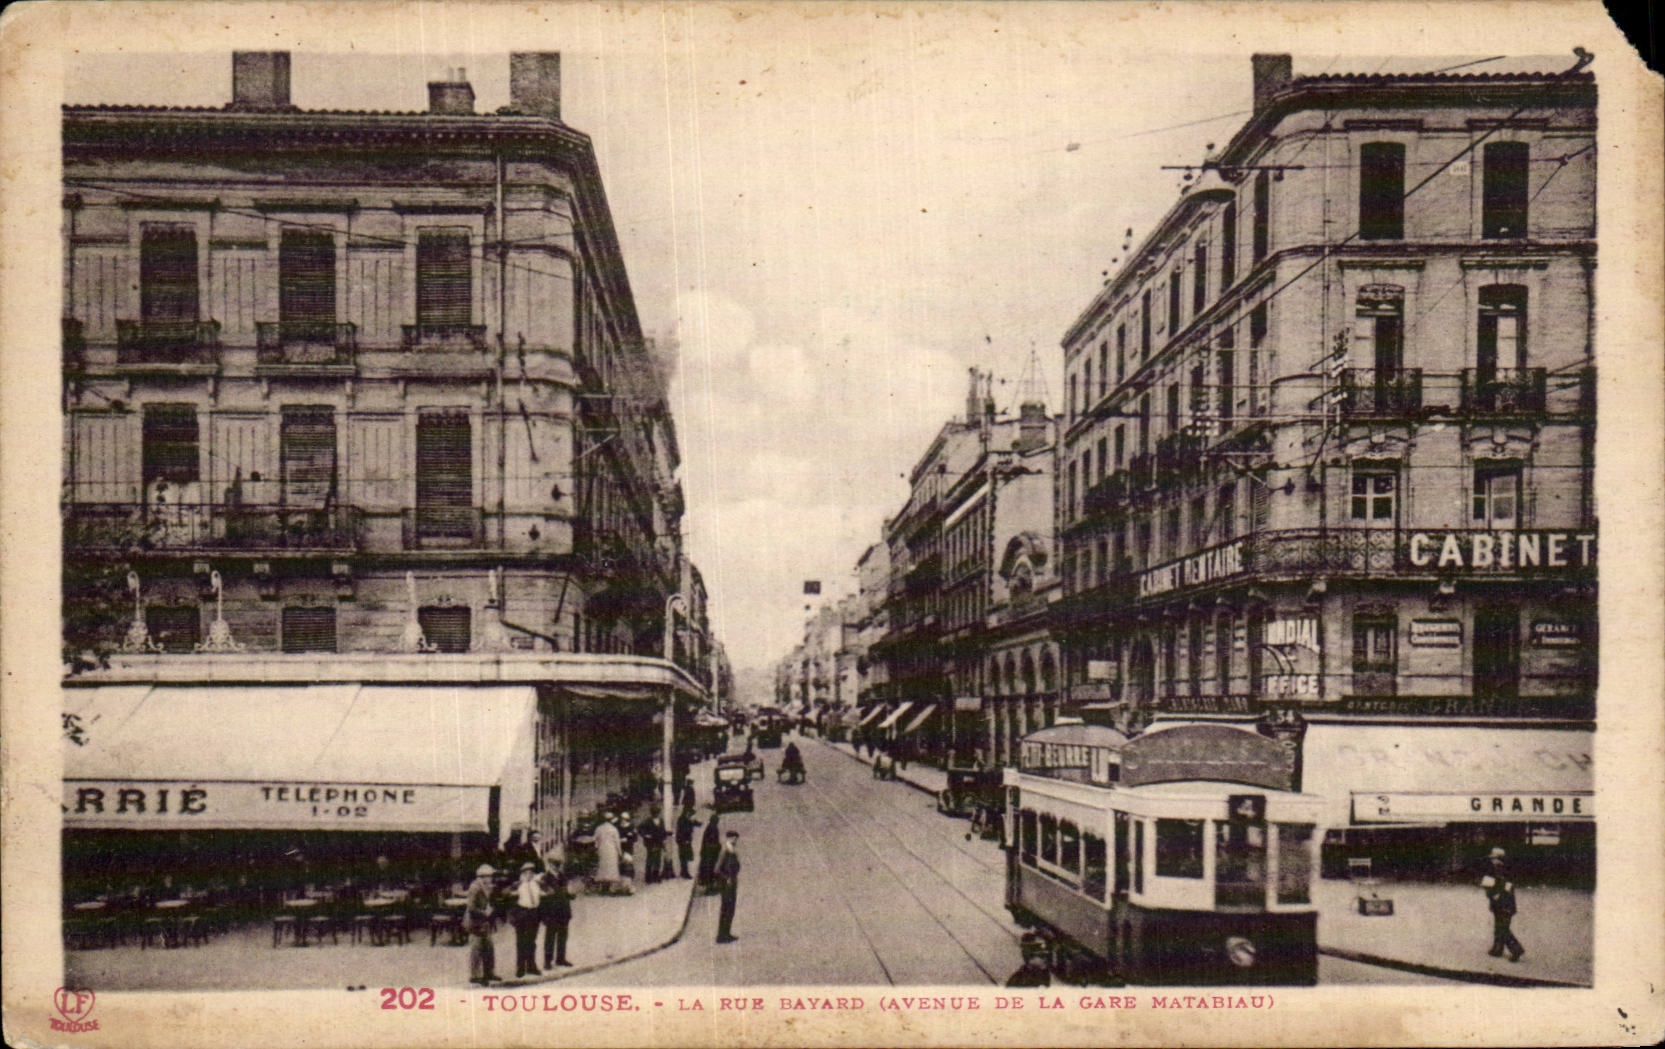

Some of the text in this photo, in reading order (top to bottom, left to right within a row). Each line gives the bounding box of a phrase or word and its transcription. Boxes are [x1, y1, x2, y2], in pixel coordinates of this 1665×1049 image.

[1410, 533, 1595, 567] CABINET
[61, 783, 207, 815] RRIÉ
[1470, 797, 1582, 814] GRANDE
